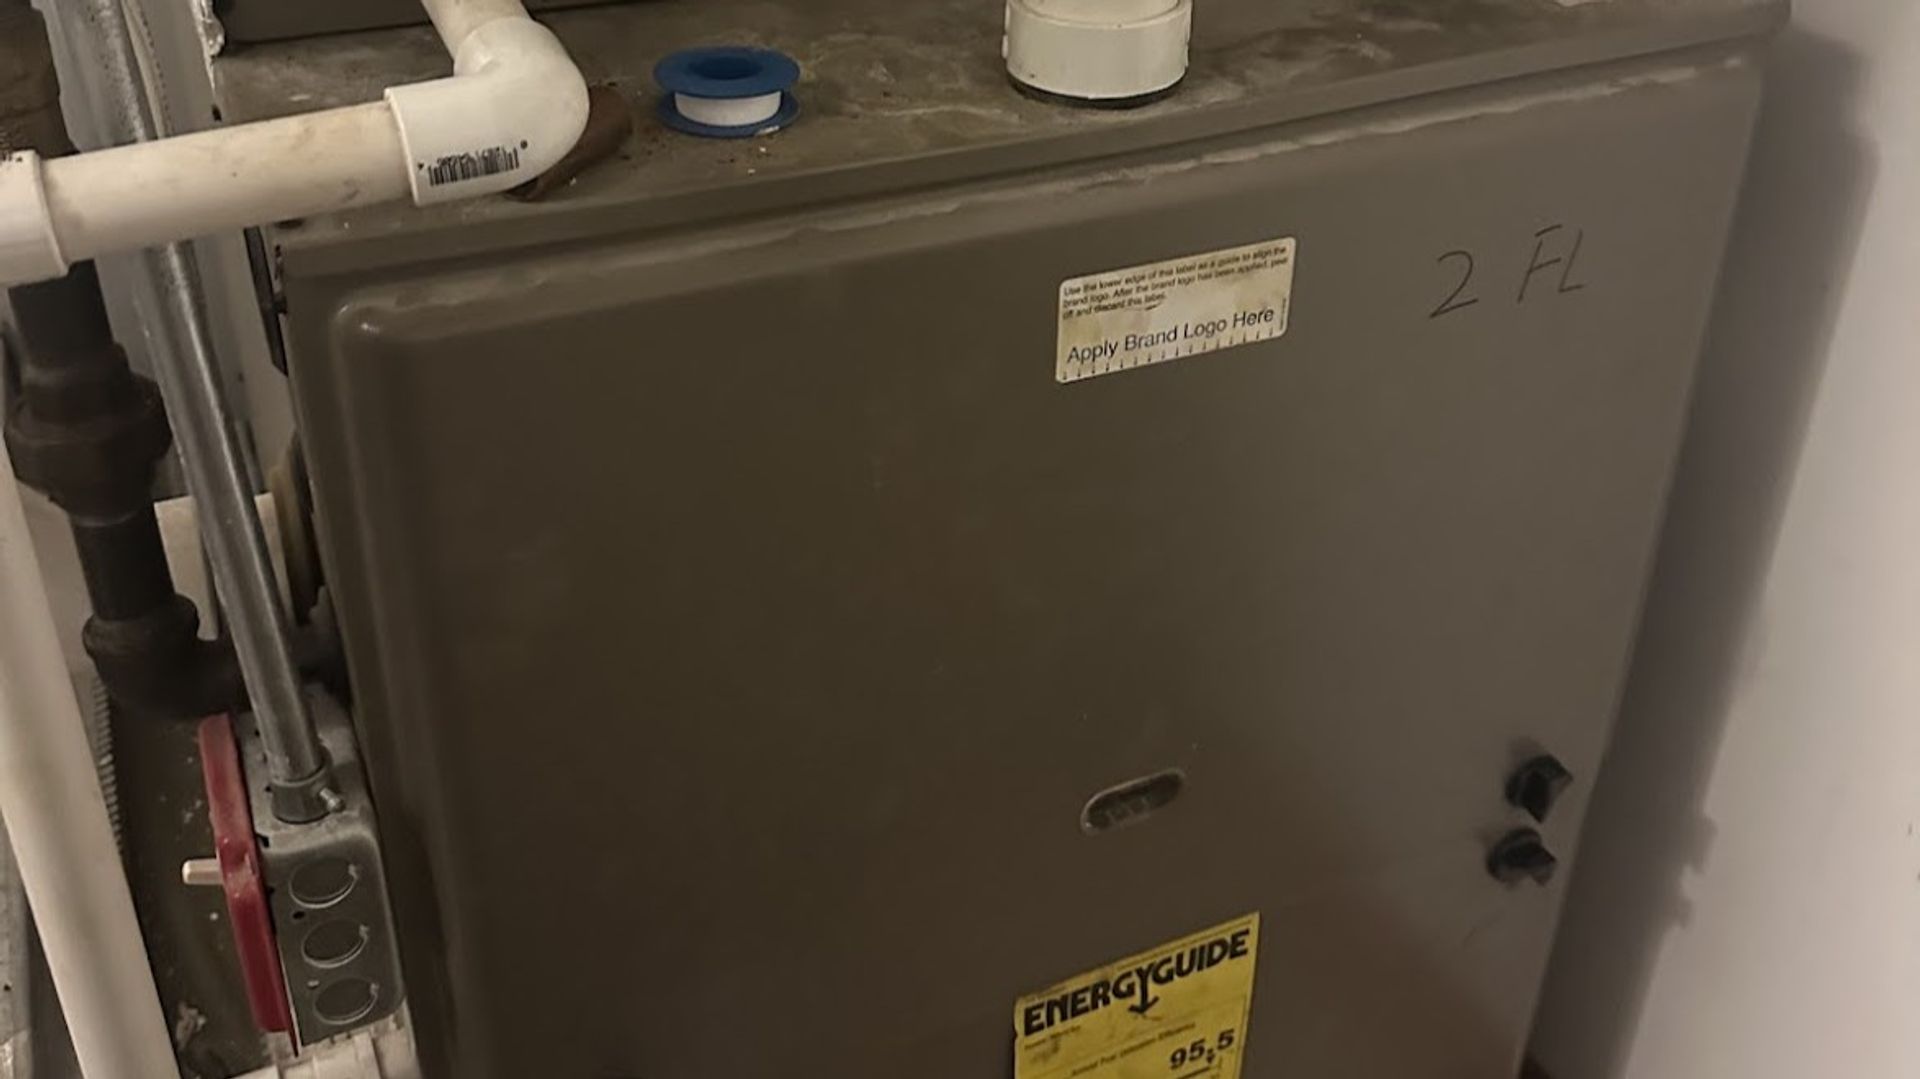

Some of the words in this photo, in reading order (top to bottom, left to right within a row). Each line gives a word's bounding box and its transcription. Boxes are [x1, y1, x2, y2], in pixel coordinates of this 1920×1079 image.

[1062, 295, 1089, 309] brand
[1113, 287, 1134, 298] After
[1135, 284, 1149, 294] the
[1150, 277, 1176, 291] brand
[1177, 275, 1196, 287] logo
[1197, 271, 1213, 281] has
[1214, 266, 1236, 278] been
[1270, 256, 1289, 269] peel
[1063, 286, 1081, 297] Use
[1083, 283, 1097, 293] the
[1099, 280, 1122, 290] lower
[1124, 275, 1146, 287] edge
[1148, 269, 1158, 281] of
[1159, 267, 1174, 277] this
[1176, 262, 1197, 274] label
[1199, 261, 1208, 270] as
[1217, 255, 1240, 269] guide
[1242, 252, 1251, 262] to
[1252, 248, 1272, 262] align
[1273, 245, 1287, 256] the
[1429, 250, 1479, 319] 2
[1517, 223, 1585, 304] FL
[1076, 305, 1092, 317] and
[1094, 300, 1126, 313] discard
[1127, 297, 1143, 307] this
[1066, 342, 1119, 366] Apply
[1124, 325, 1178, 352] Brand
[1184, 315, 1228, 339] Logo
[1232, 306, 1275, 328] Here
[1023, 928, 1250, 1037] ENERGYGUIDE
